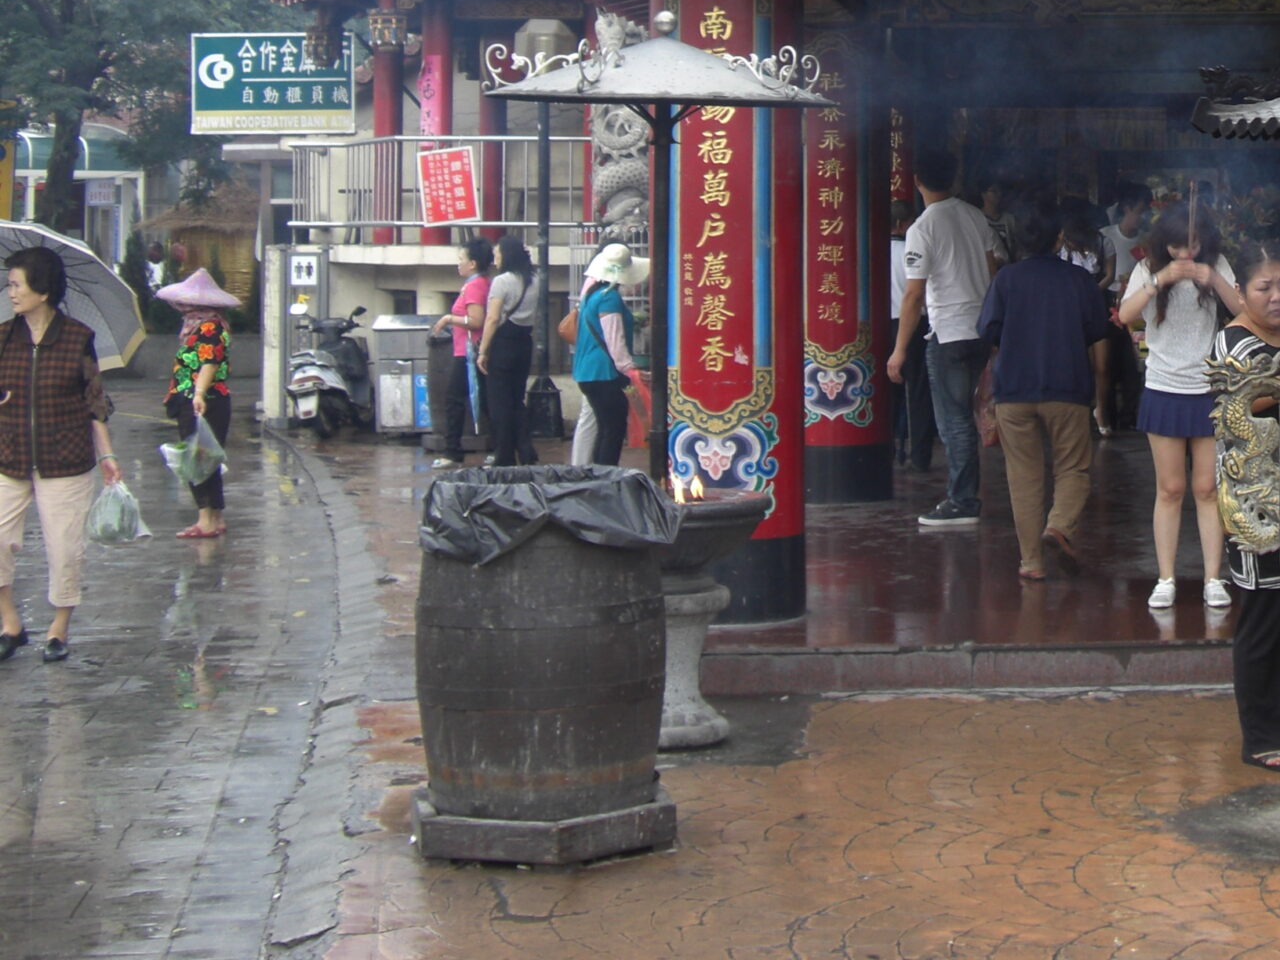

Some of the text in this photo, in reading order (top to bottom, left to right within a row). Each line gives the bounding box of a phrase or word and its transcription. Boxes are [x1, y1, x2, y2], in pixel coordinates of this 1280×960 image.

[242, 85, 350, 105] 自動櫃員機
[195, 116, 233, 129] TAIWAN
[234, 116, 300, 129] COOPERATIVE
[301, 116, 328, 129] BANK
